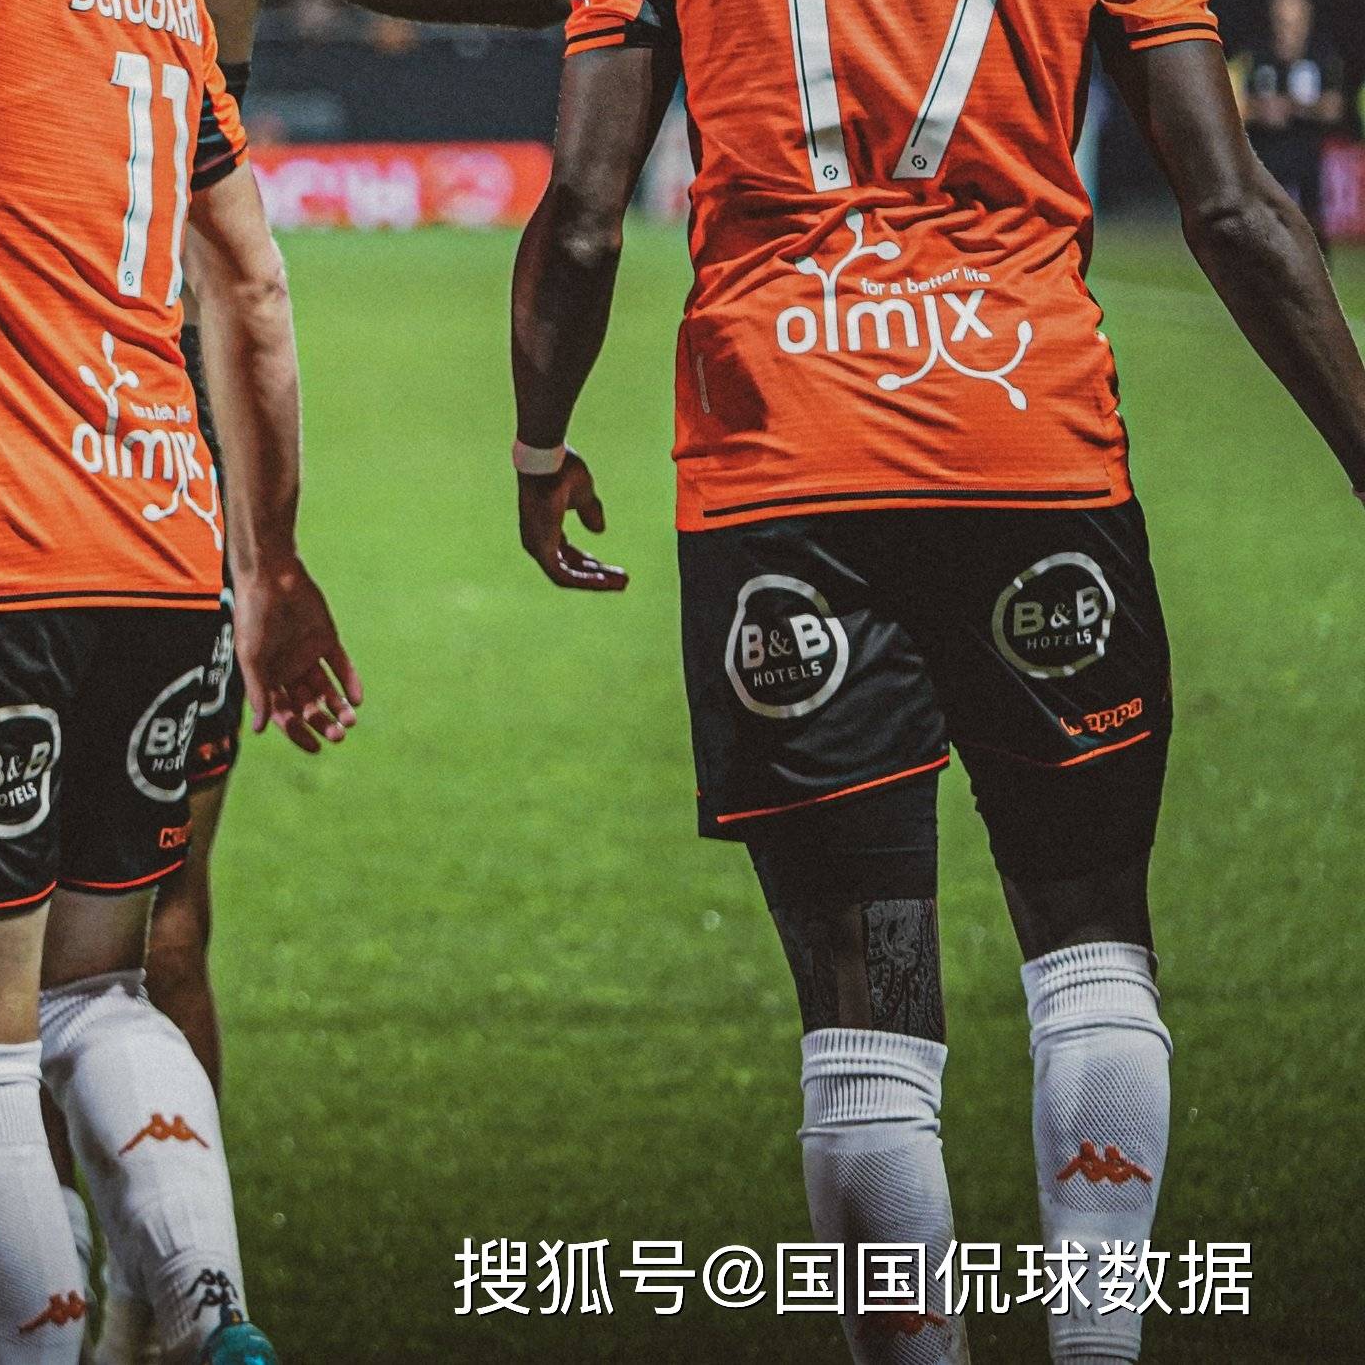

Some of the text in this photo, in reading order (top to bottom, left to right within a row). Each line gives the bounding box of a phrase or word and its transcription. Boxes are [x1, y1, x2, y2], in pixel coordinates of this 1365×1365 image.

[110, 51, 189, 307] 11
[890, 282, 902, 294] a
[1014, 586, 1101, 636] B&B
[742, 613, 829, 669] B&B
[1027, 629, 1092, 649] HOTELS
[753, 661, 823, 687] HOTELS
